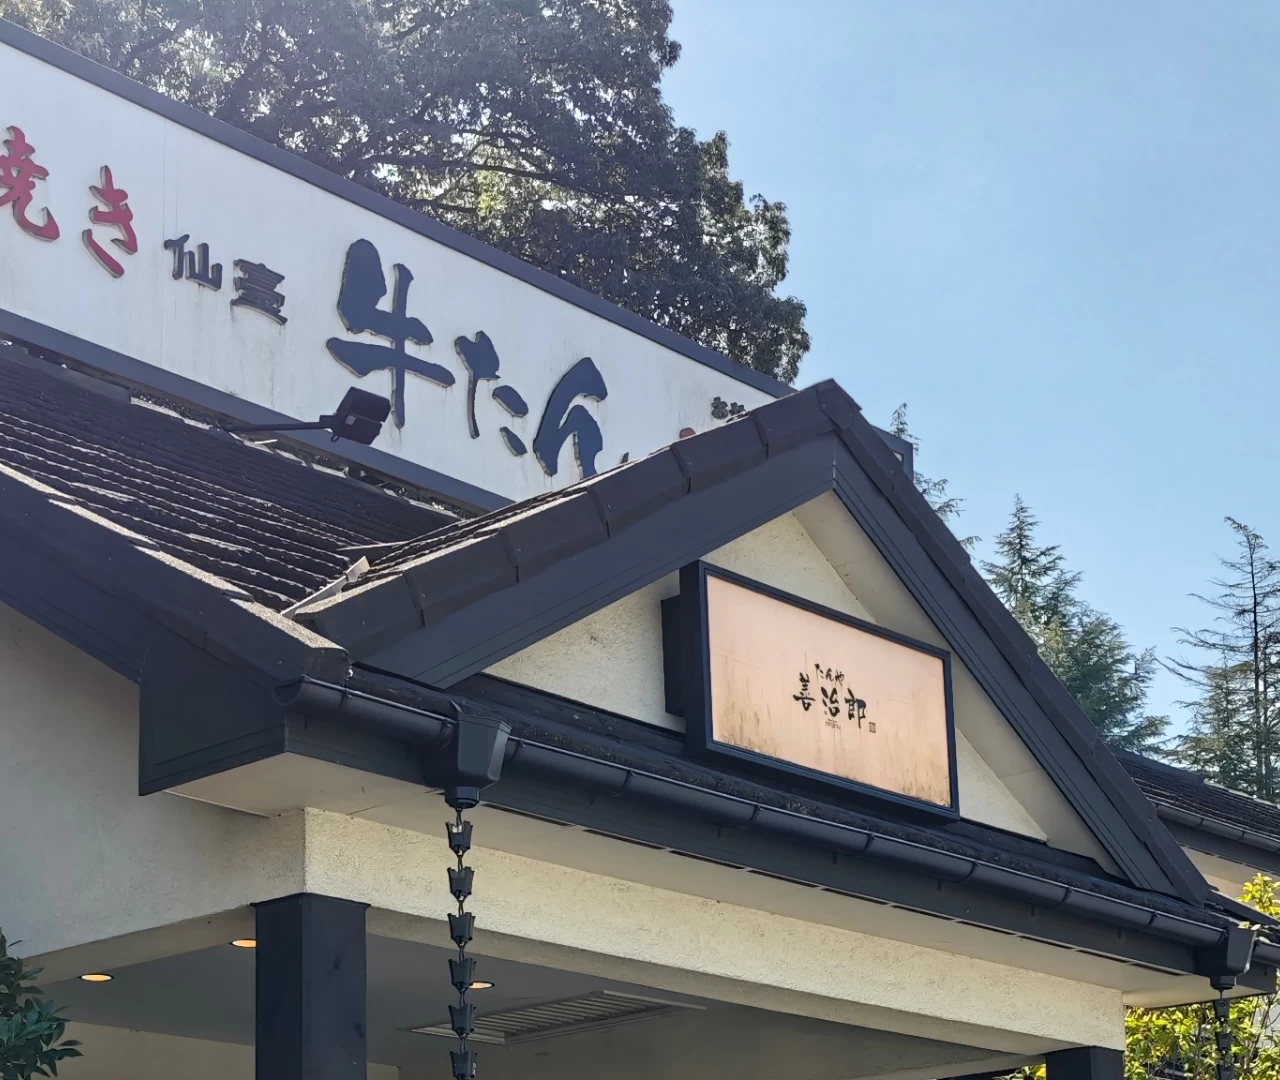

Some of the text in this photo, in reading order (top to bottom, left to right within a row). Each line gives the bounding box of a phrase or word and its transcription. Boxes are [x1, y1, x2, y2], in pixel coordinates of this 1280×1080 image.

[325, 237, 608, 481] 牛たん
[792, 671, 867, 730] 善治郎
